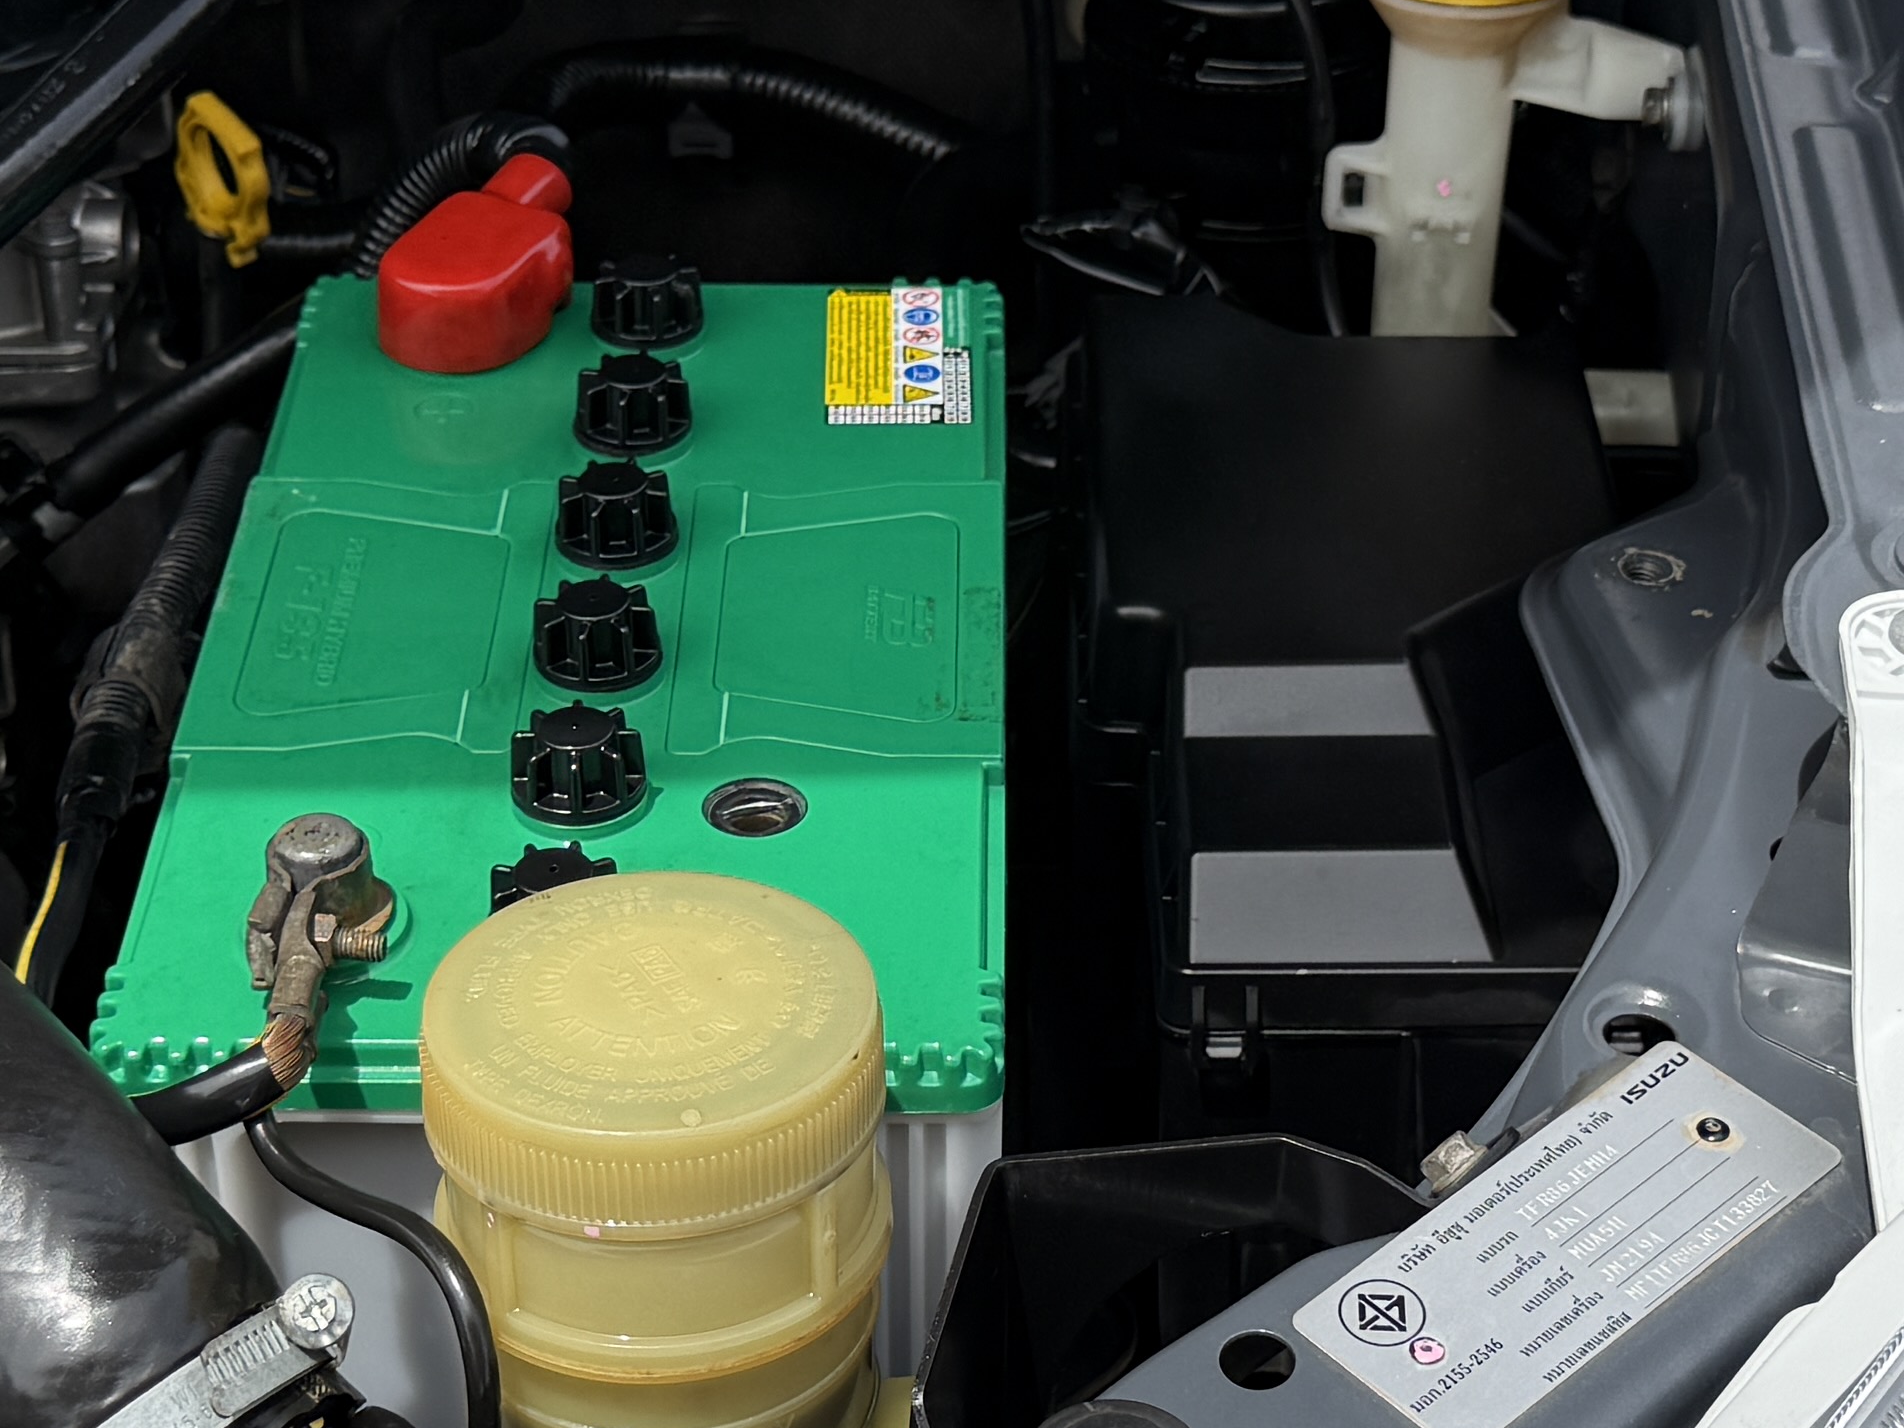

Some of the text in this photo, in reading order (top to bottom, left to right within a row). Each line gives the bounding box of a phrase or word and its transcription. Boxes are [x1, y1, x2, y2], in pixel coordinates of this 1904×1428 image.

[548, 1011, 744, 1059] ATTENTION
[1619, 1051, 1689, 1105] ISUZU
[1409, 1337, 1503, 1413] มอก.2155-2546
